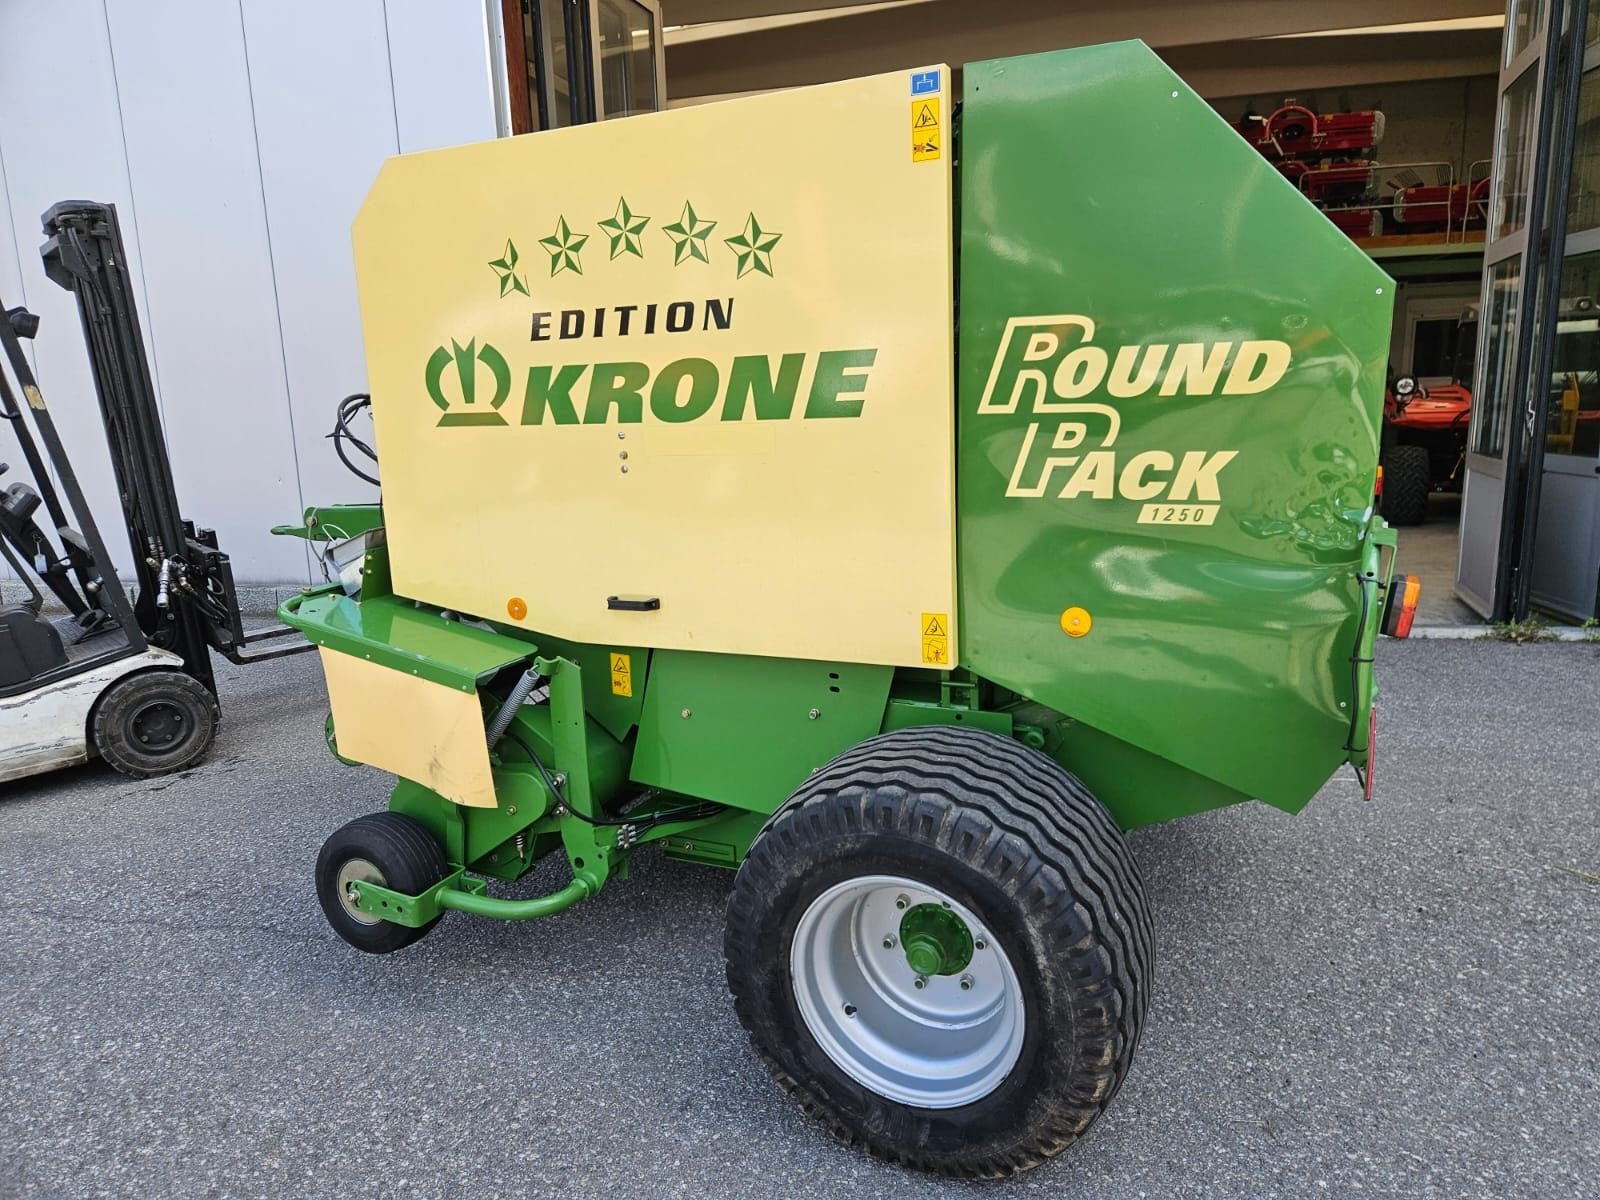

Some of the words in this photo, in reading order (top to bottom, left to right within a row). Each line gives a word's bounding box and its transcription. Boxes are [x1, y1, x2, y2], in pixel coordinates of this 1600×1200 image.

[530, 298, 734, 341] EDITION
[520, 348, 878, 426] KRONE
[977, 314, 1292, 414] ROUND
[1004, 403, 1240, 501] PACK
[1151, 507, 1205, 522] 1250
